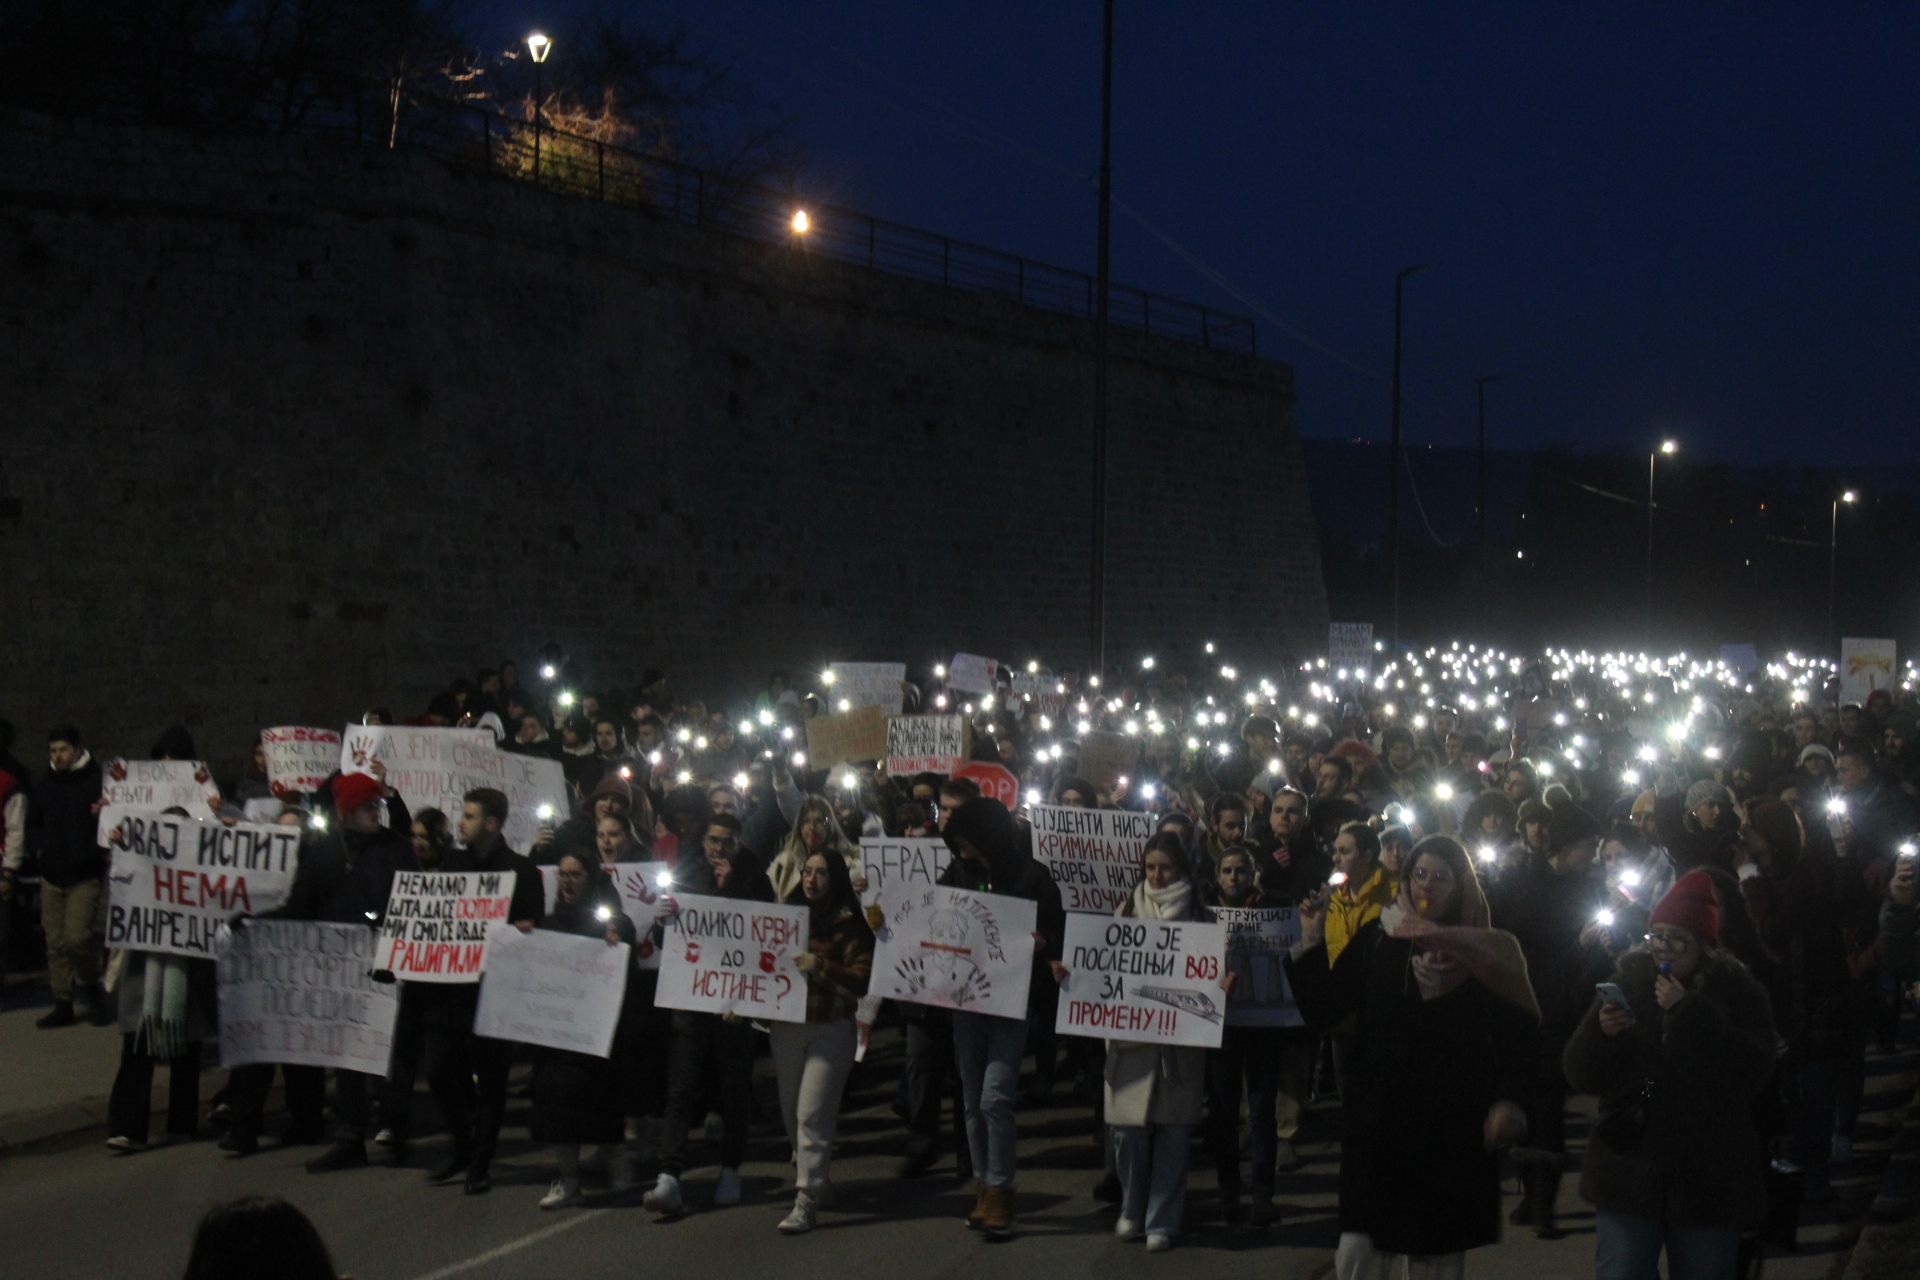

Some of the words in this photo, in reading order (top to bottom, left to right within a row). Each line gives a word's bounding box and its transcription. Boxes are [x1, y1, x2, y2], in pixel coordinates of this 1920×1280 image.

[1032, 807, 1104, 836] СТУДЕНТИ
[1111, 813, 1151, 839] НИСУ
[118, 815, 179, 860] ОВАЈ
[197, 826, 296, 872] ИСПИТ
[397, 873, 467, 897] НЕМАМО
[1049, 860, 1099, 886] БОРБА
[153, 864, 252, 912] НЕМА
[672, 907, 745, 940] КОЛИКО
[750, 914, 800, 947] КРВИ
[1216, 908, 1293, 923] СТРУКЦИЈУ
[1226, 922, 1264, 935] ДРЖЕ
[383, 918, 408, 940] МИ
[412, 919, 438, 941] СМО
[1105, 923, 1147, 948] ОВО
[1156, 926, 1183, 952] ЈЕ
[387, 939, 484, 974] РАШИРИЛИ
[720, 949, 745, 968] ДО
[1073, 945, 1175, 977] ПОСЛЕДЊИ
[1185, 954, 1219, 980] ВОЗ
[1099, 975, 1124, 1001] ЗА
